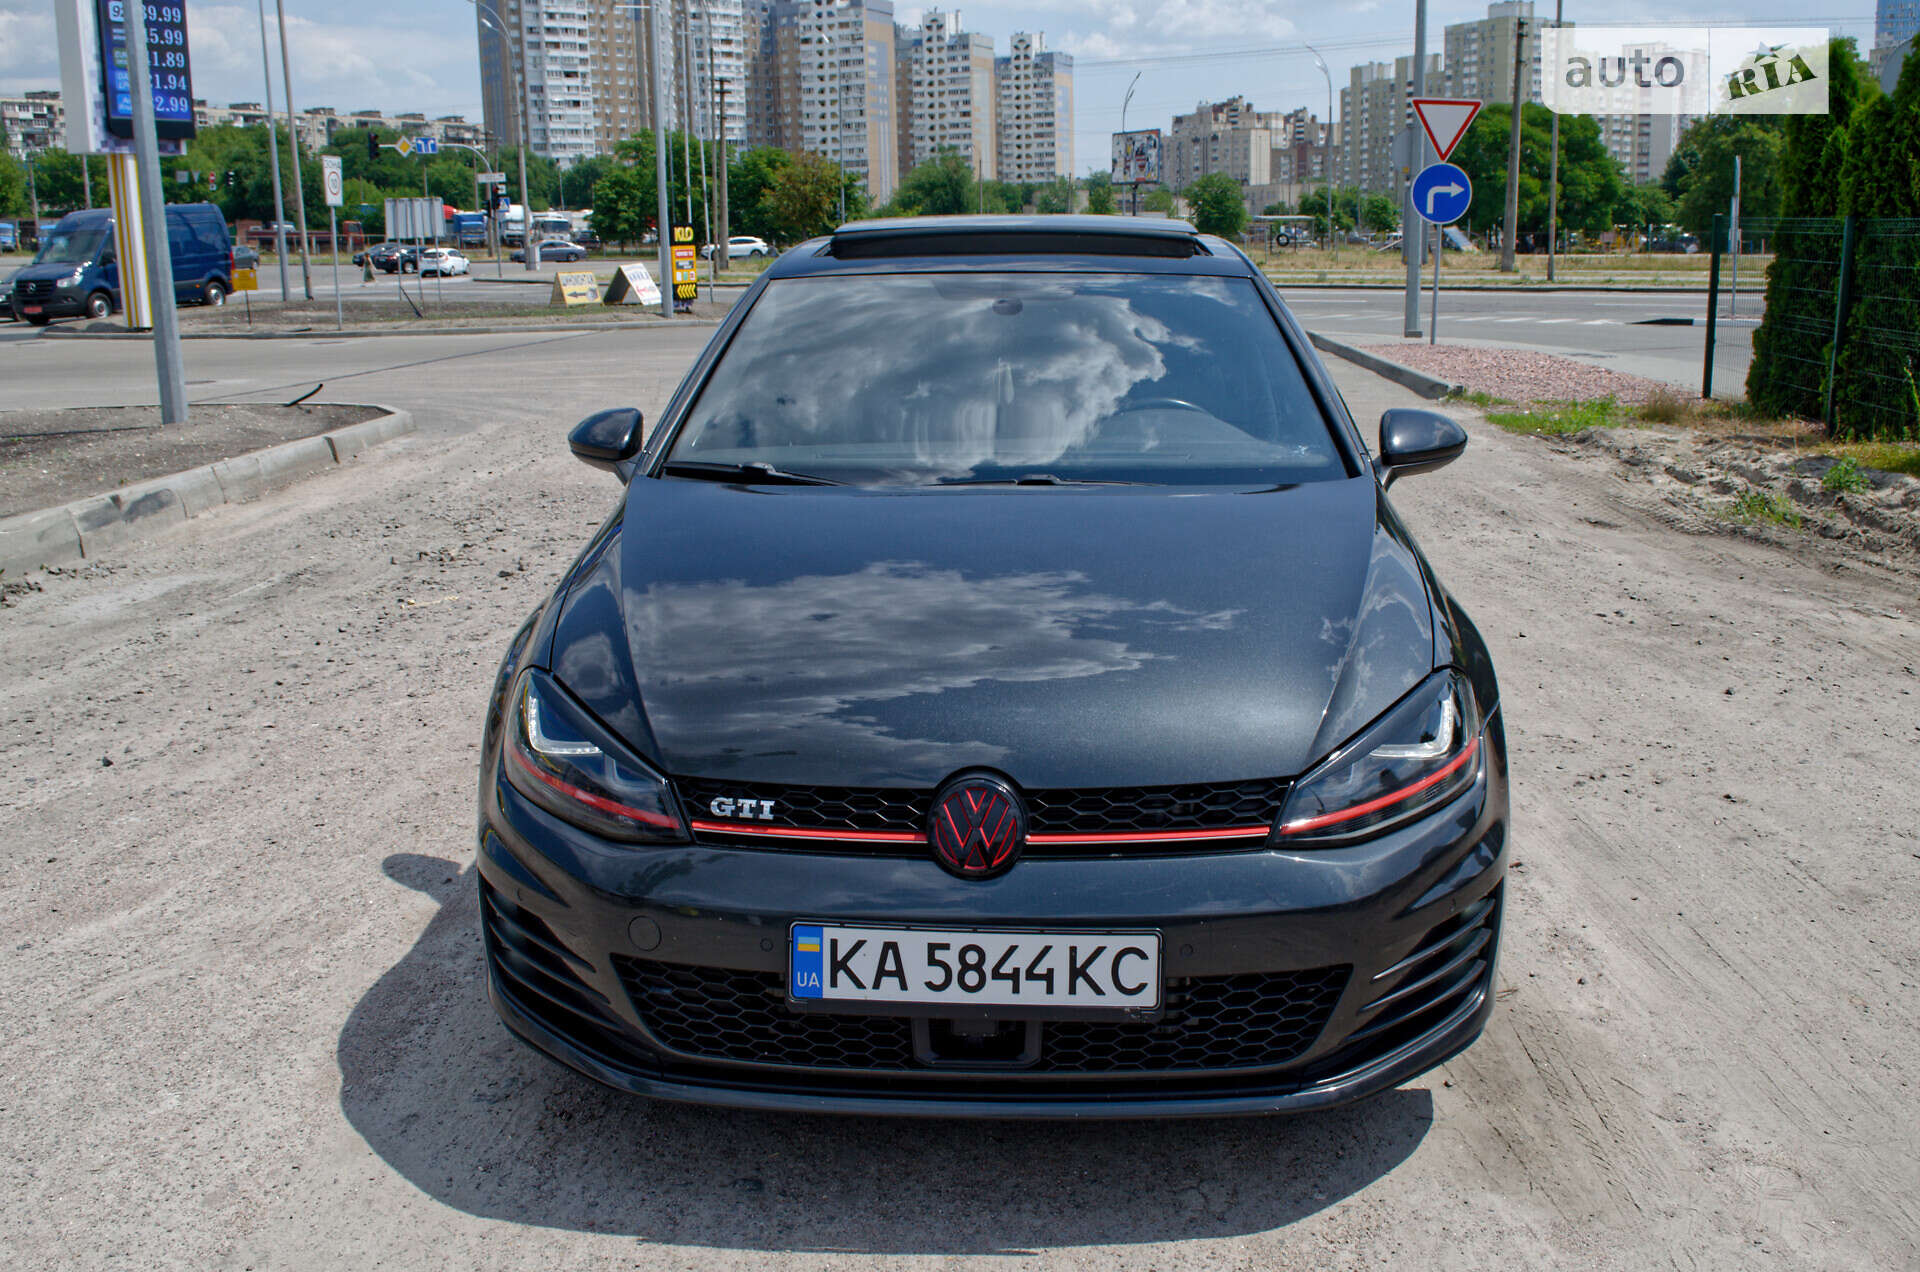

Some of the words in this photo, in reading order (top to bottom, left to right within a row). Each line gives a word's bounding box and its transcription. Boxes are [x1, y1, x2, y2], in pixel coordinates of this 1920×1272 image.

[146, 28, 183, 46] 5.99
[148, 51, 185, 68] 1.89
[150, 73, 187, 91] 1.94
[152, 95, 189, 112] 2.99
[709, 796, 776, 820] GTI
[829, 937, 909, 992] KA
[923, 941, 1055, 996] 5844
[1067, 944, 1150, 997] KC
[797, 971, 821, 988] UA
